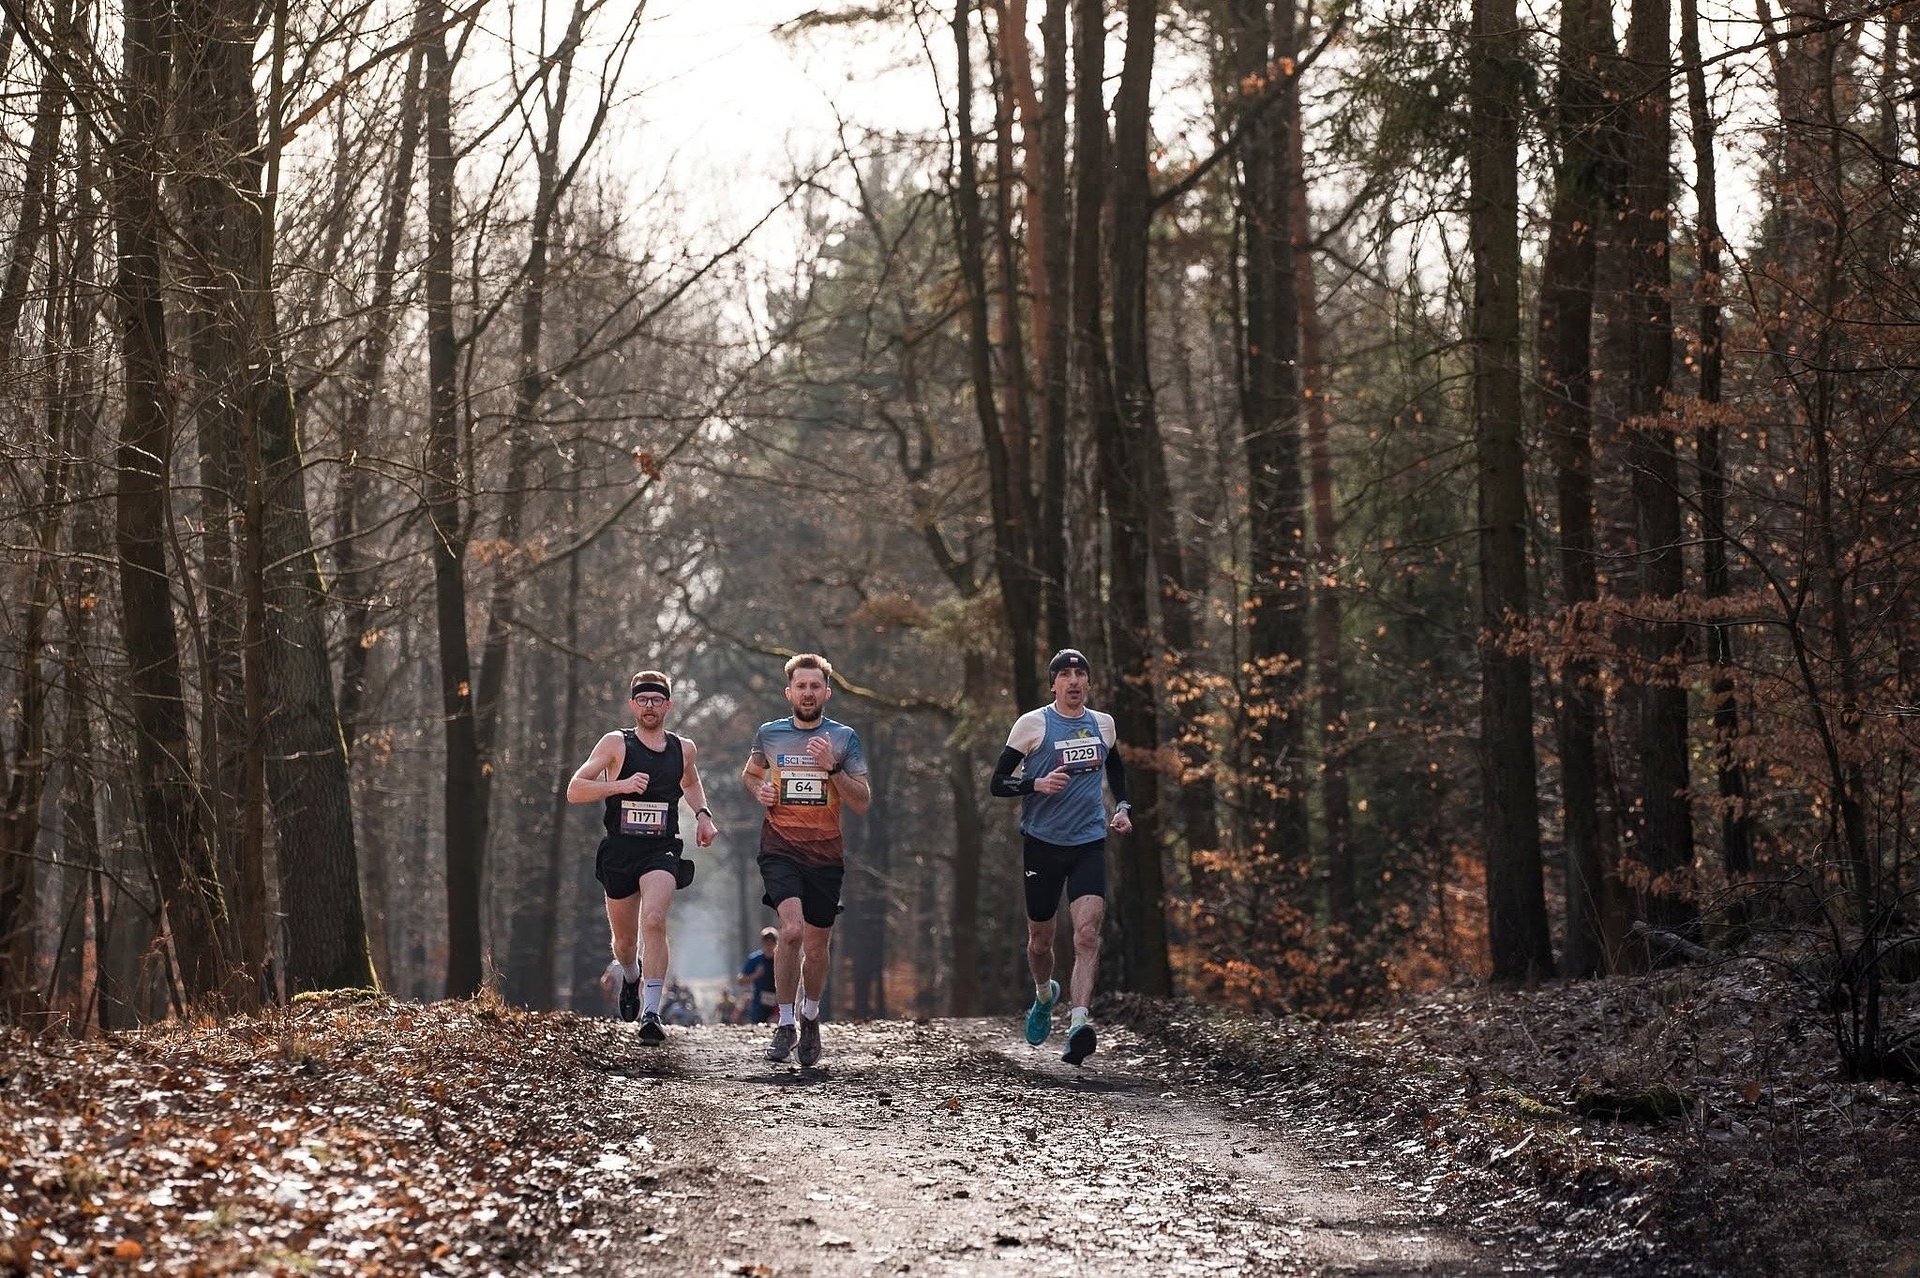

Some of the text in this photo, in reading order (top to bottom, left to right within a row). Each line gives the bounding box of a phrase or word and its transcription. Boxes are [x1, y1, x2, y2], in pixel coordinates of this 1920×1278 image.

[1065, 748, 1094, 761] 1229
[795, 781, 813, 792] 64
[632, 812, 656, 823] 1171
